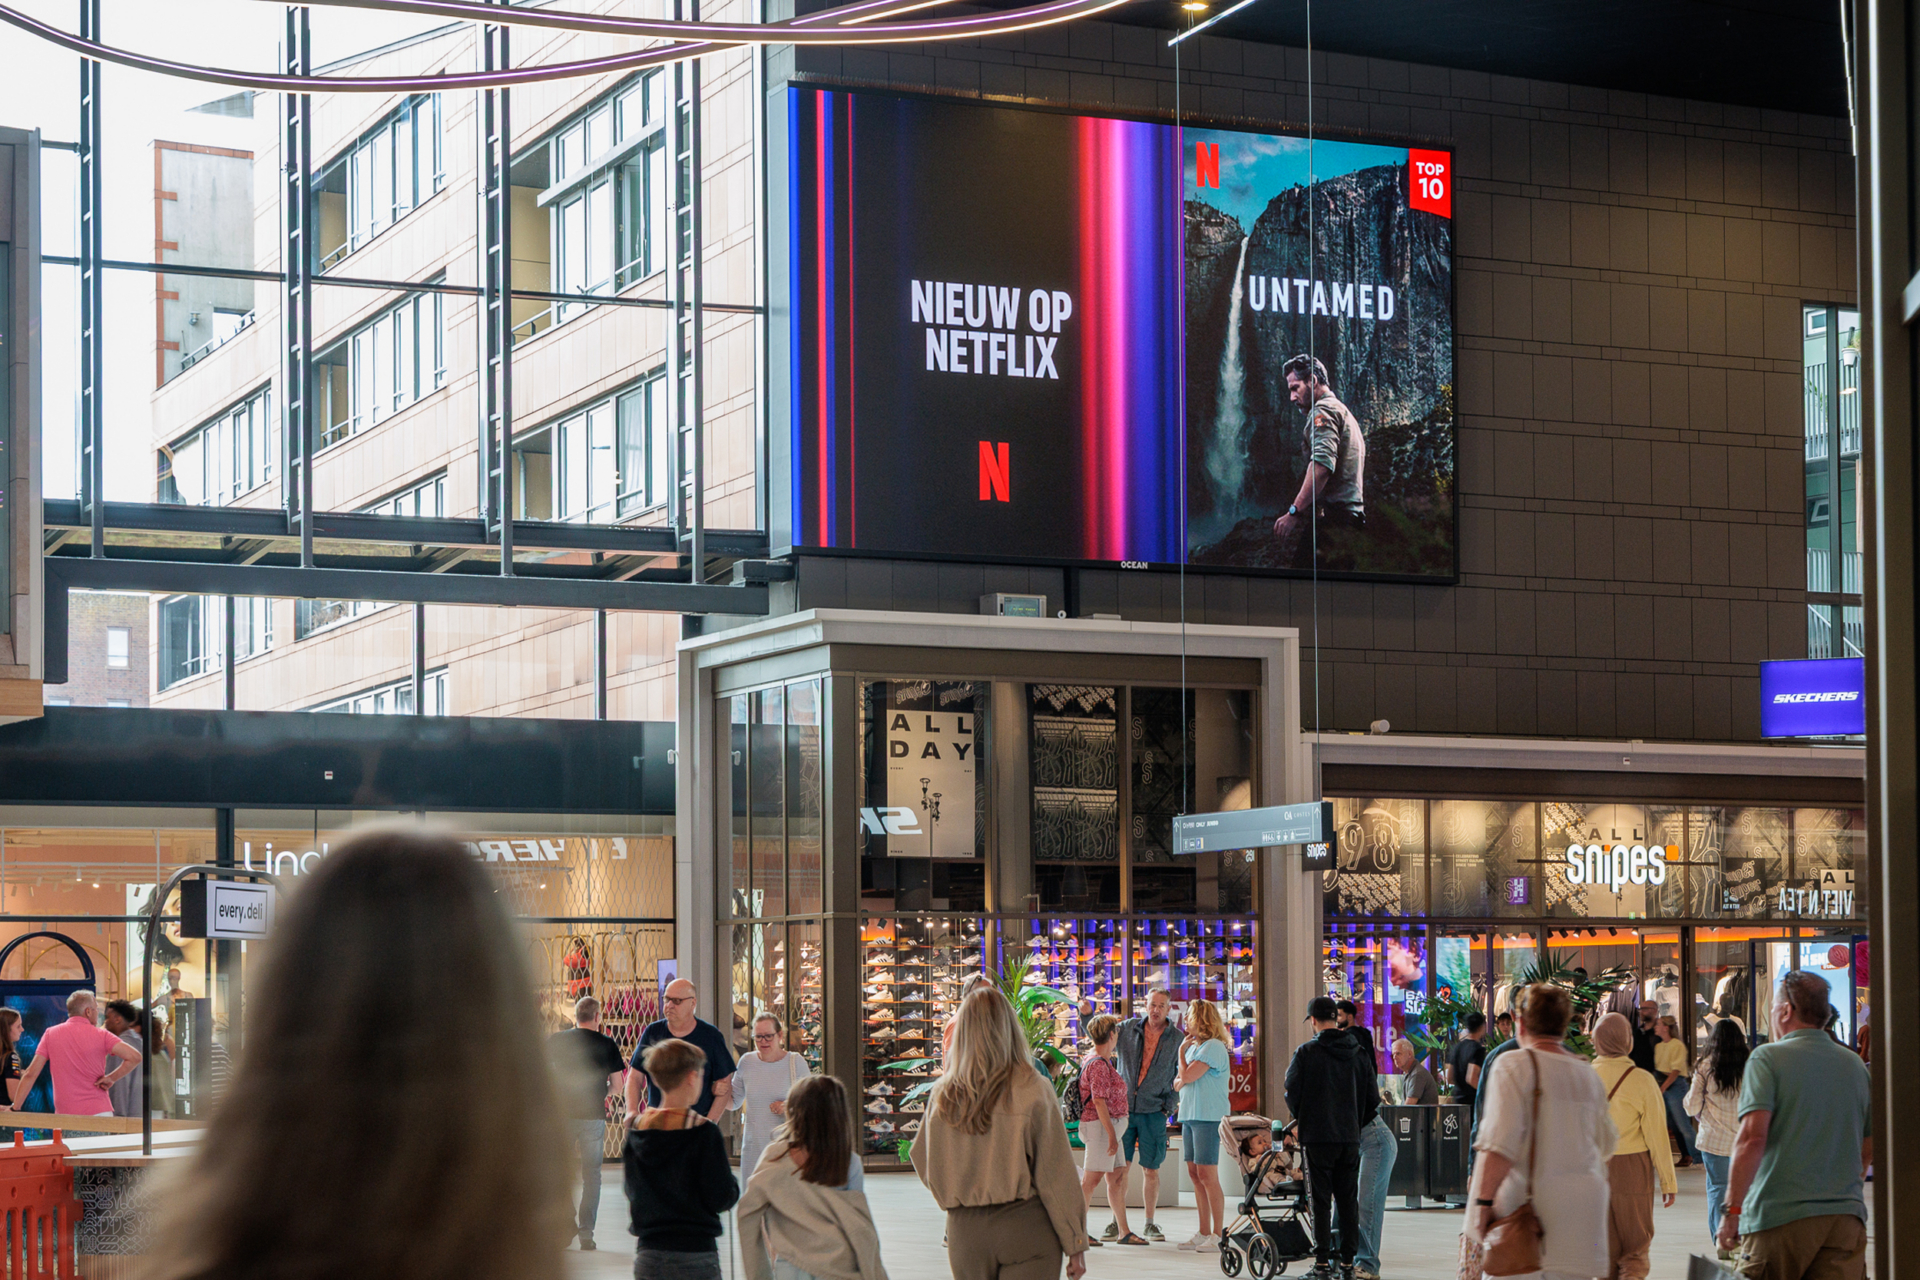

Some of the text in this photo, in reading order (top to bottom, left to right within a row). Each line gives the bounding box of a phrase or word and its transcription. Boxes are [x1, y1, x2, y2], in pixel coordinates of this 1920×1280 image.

[1196, 141, 1220, 189] N
[1416, 161, 1445, 176] TOP
[1418, 177, 1444, 200] 10
[911, 279, 1072, 333] NIEUW OP
[1250, 275, 1394, 321] UNTAMED
[926, 328, 1059, 380] NETFLIX
[979, 440, 1010, 502] N
[1120, 560, 1148, 569] OCEAN
[1773, 691, 1859, 704] SKECHERS
[890, 713, 972, 735] ALL
[890, 740, 972, 761] DAY
[1588, 828, 1643, 841] ALL
[1307, 843, 1327, 860] snipes
[1565, 844, 1666, 893] snipes
[219, 902, 263, 924] every.deli
